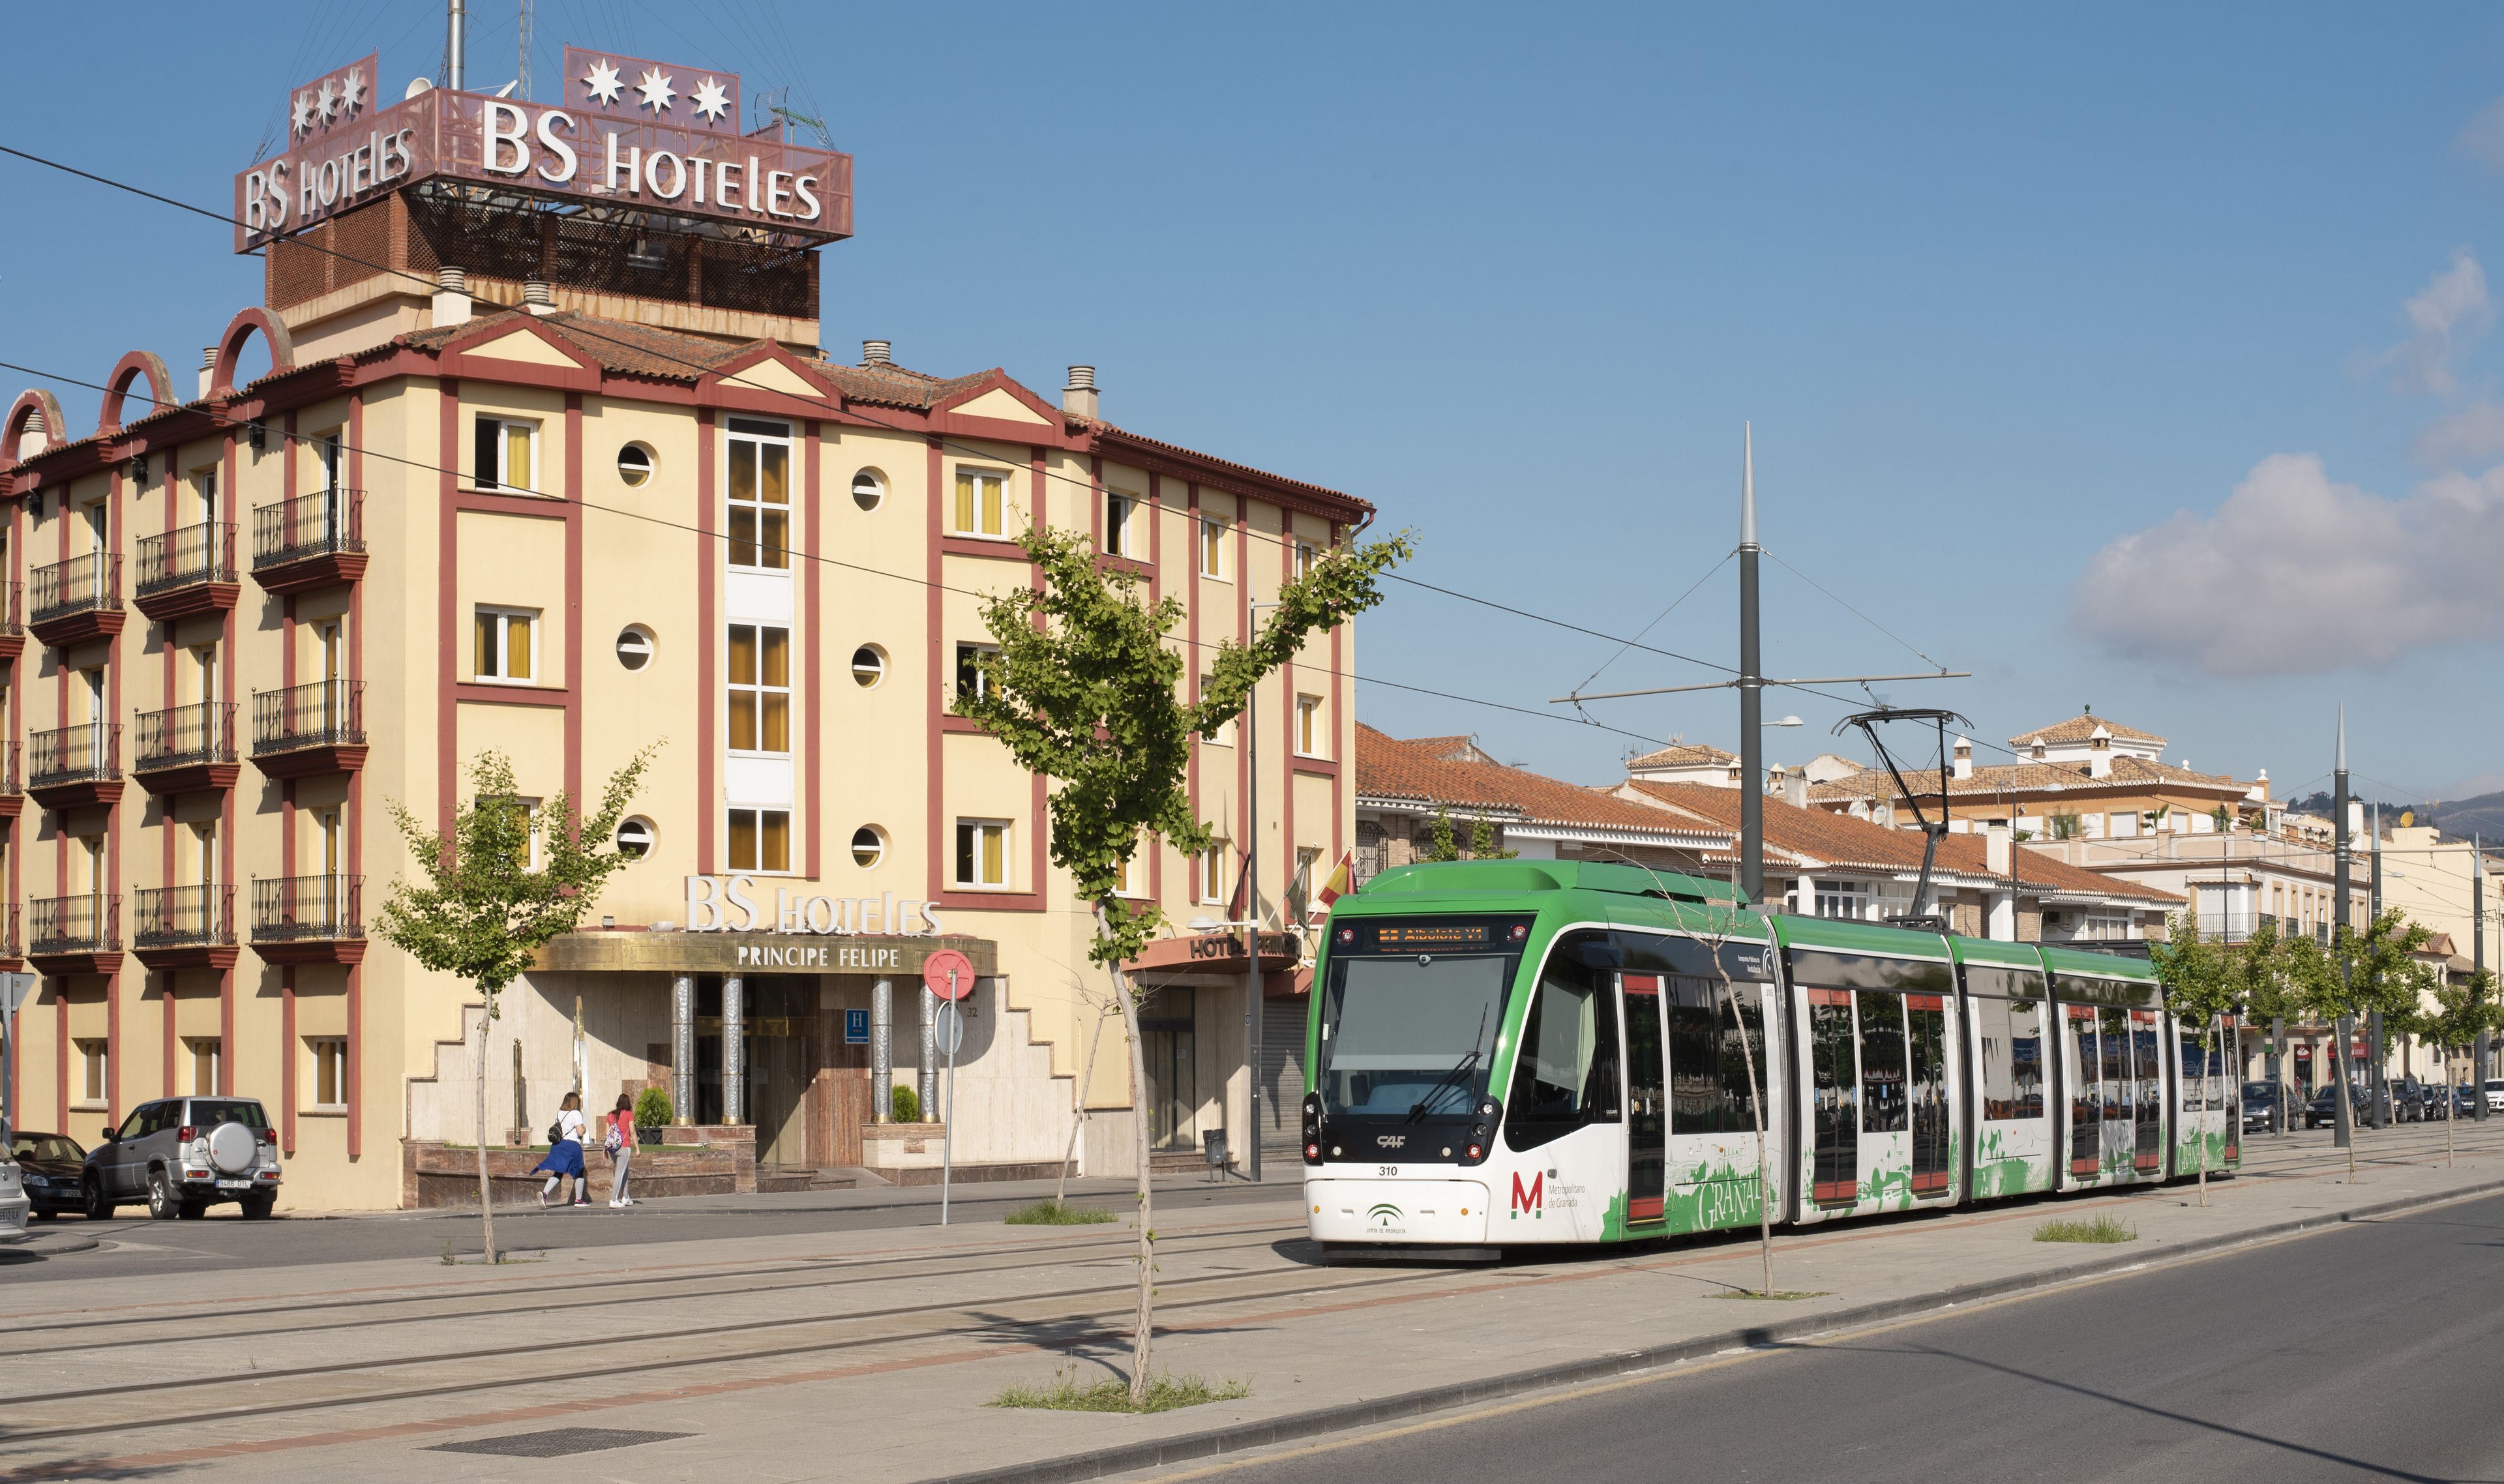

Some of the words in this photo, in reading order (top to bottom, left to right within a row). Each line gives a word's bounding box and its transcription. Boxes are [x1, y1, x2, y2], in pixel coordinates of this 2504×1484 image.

[484, 100, 577, 183] BS
[606, 132, 820, 220] HOTELES
[246, 160, 288, 237] BS
[300, 128, 410, 216] HOTELES
[685, 875, 758, 932] BS
[775, 887, 942, 937] HOTELES
[738, 947, 828, 967] PRINCIPE
[840, 949, 899, 968] FELIPE
[967, 1007, 977, 1017] 32
[852, 1012, 863, 1028] H
[1377, 1135, 1406, 1148] CAF
[1379, 1166, 1397, 1176] 310
[1549, 1183, 1585, 1196] Metropolitano
[1548, 1198, 1555, 1208] de
[1556, 1197, 1578, 1208] Granada
